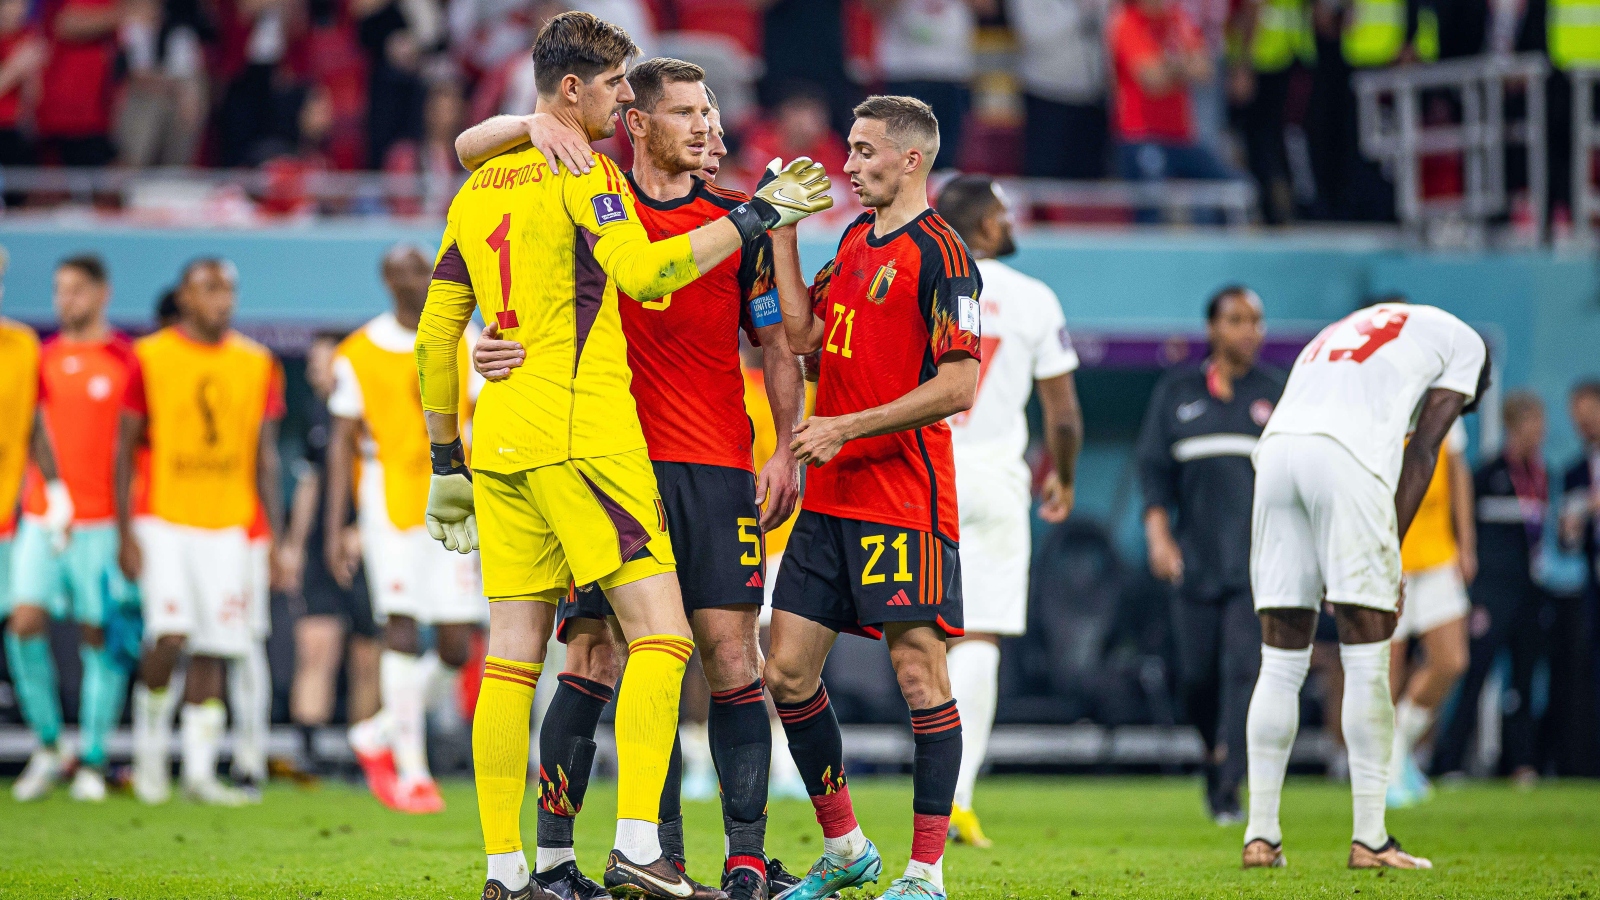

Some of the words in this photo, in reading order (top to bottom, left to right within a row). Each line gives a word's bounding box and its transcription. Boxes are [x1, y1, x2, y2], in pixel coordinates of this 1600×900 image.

[485, 212, 520, 330] 1
[752, 295, 774, 304] FOOTBALL
[753, 300, 776, 311] UNITES
[825, 302, 856, 358] 21
[737, 517, 761, 566] 5
[860, 532, 913, 585] 21
